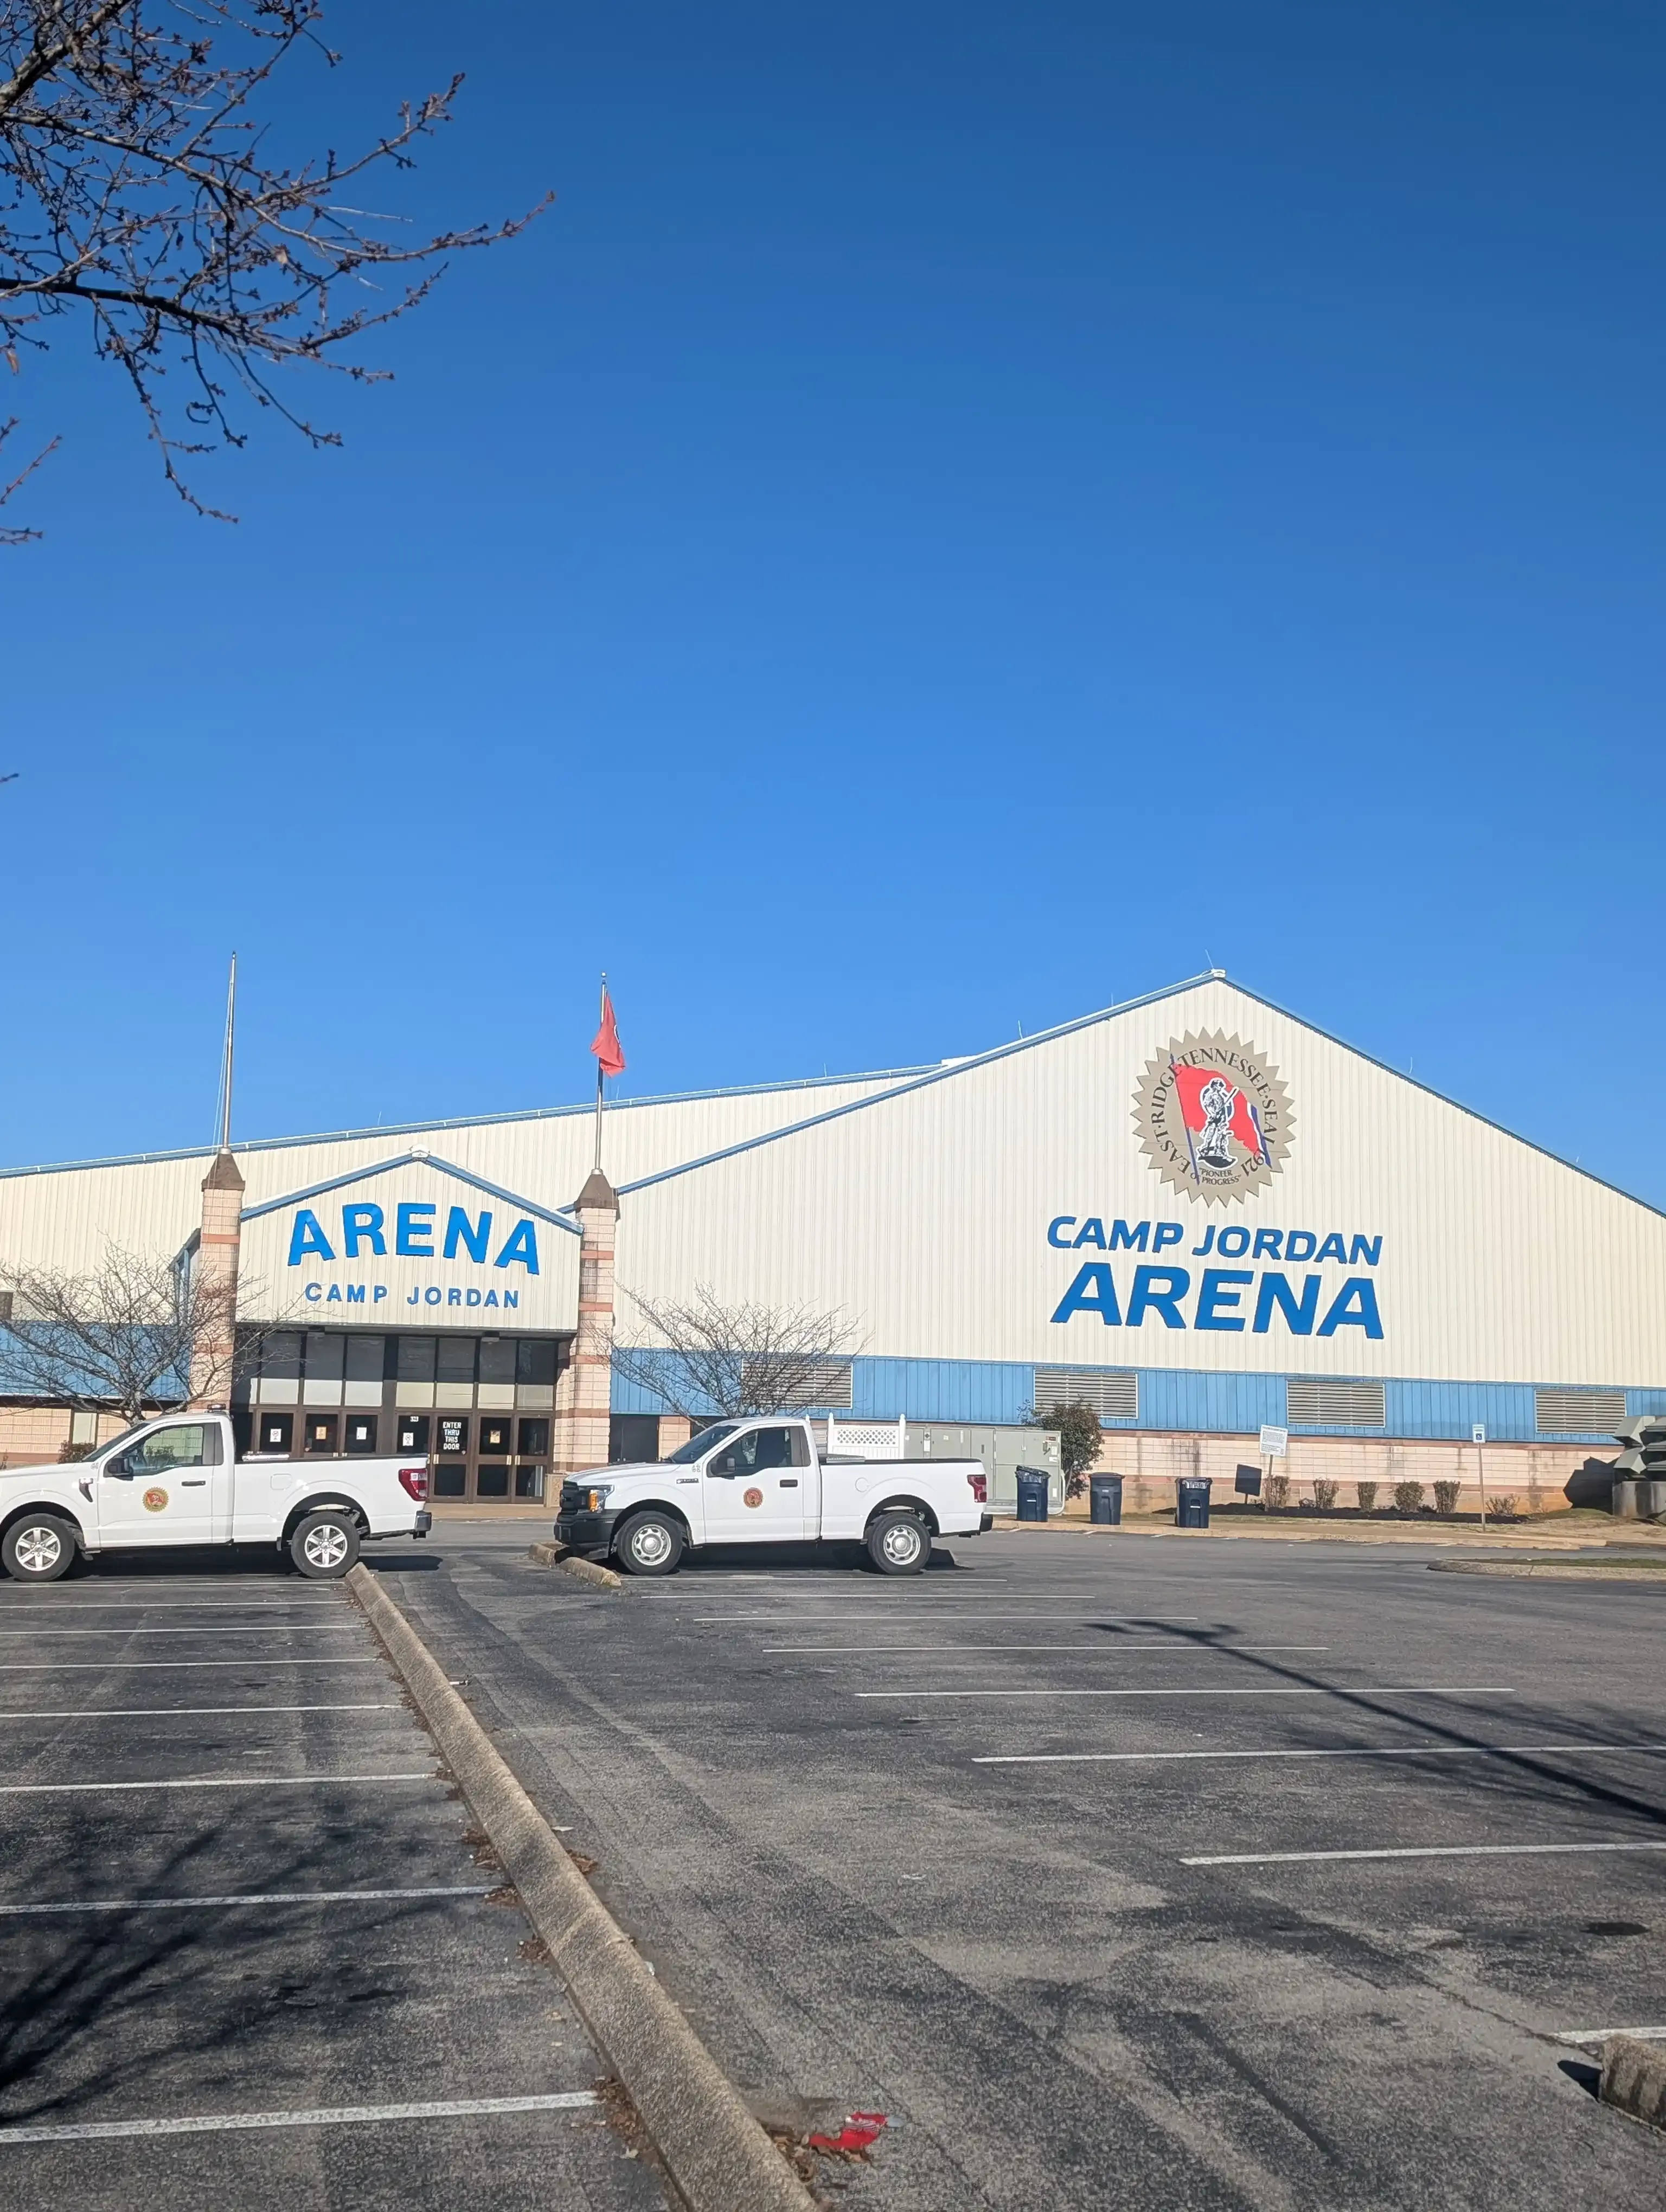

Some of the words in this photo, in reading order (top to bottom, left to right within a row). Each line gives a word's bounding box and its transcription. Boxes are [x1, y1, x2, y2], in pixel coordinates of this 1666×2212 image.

[1151, 1063, 1182, 1124] RIDGE
[1177, 1048, 1271, 1097] TENNESSEE
[1154, 1129, 1190, 1174] EAST
[287, 1203, 540, 1275] ARENA
[1047, 1216, 1184, 1253] CAMP
[1192, 1225, 1383, 1266] JORDAN
[305, 1283, 387, 1303] CAMP
[407, 1287, 519, 1308] JORDAN
[1050, 1262, 1384, 1339] ARENA
